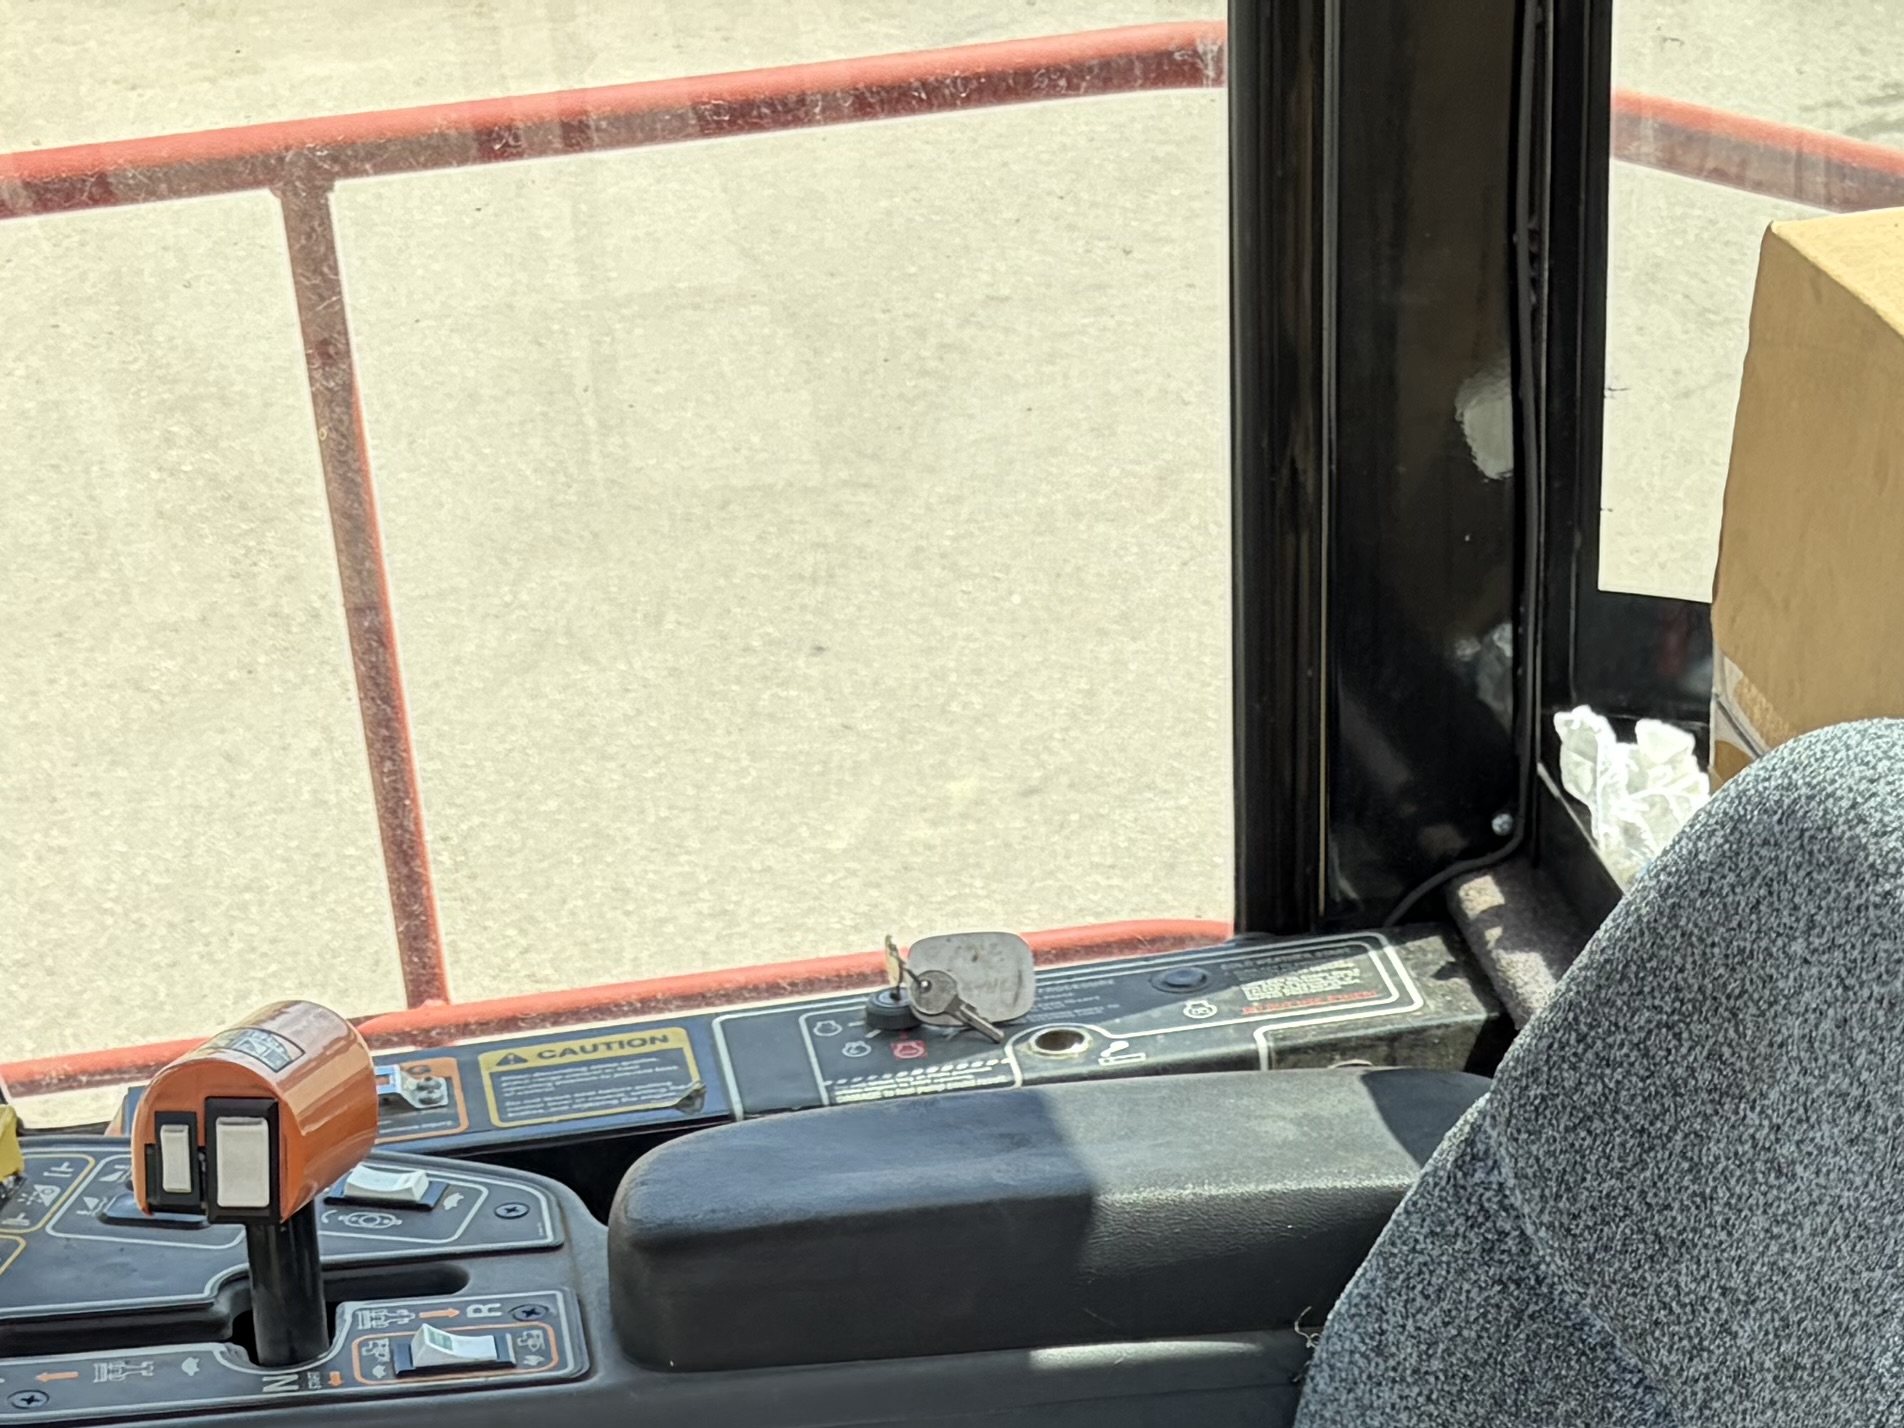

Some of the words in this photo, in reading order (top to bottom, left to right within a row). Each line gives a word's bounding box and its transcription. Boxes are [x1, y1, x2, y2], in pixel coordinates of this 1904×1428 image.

[537, 1034, 670, 1061] CAUTION
[466, 1302, 503, 1318] R
[261, 1373, 300, 1393] N
